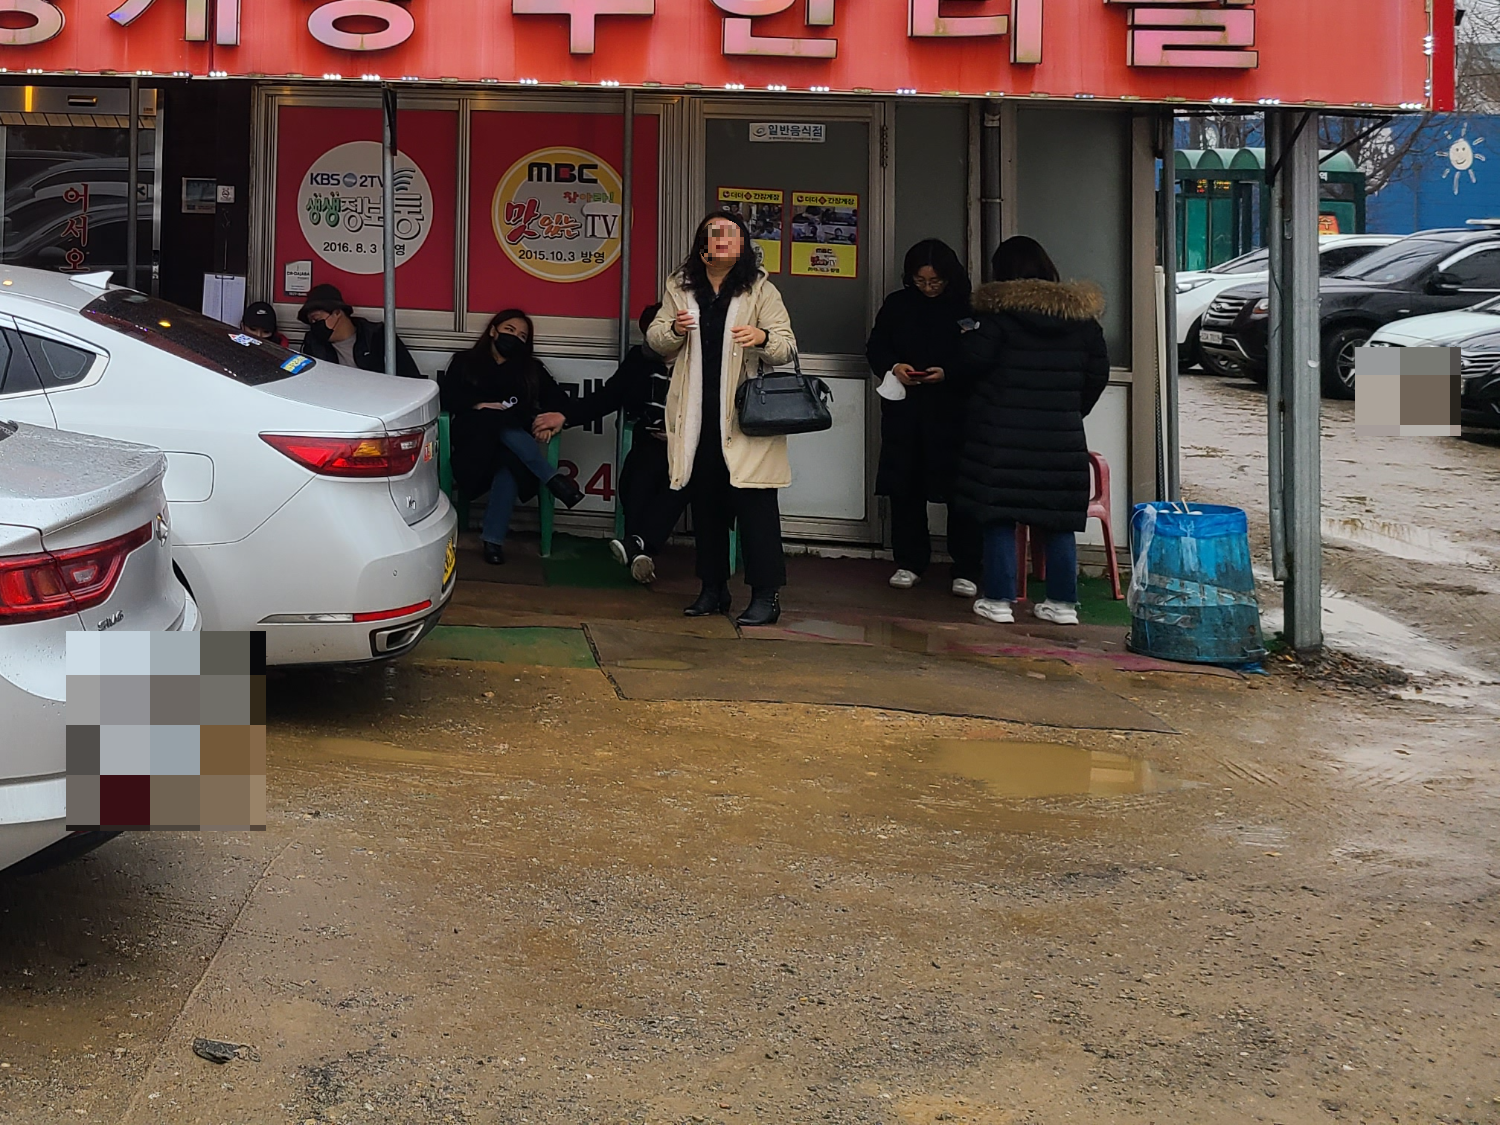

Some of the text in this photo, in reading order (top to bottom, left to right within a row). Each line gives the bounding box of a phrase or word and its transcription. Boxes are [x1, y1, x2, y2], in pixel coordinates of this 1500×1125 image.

[768, 124, 822, 137] 일반음식점
[310, 173, 340, 186] KBS
[527, 162, 598, 184] MBC
[563, 191, 615, 203] 찾아라!
[586, 214, 618, 238] TV
[323, 242, 352, 253] 2016.
[370, 243, 377, 254] 3
[581, 251, 605, 264] 방영
